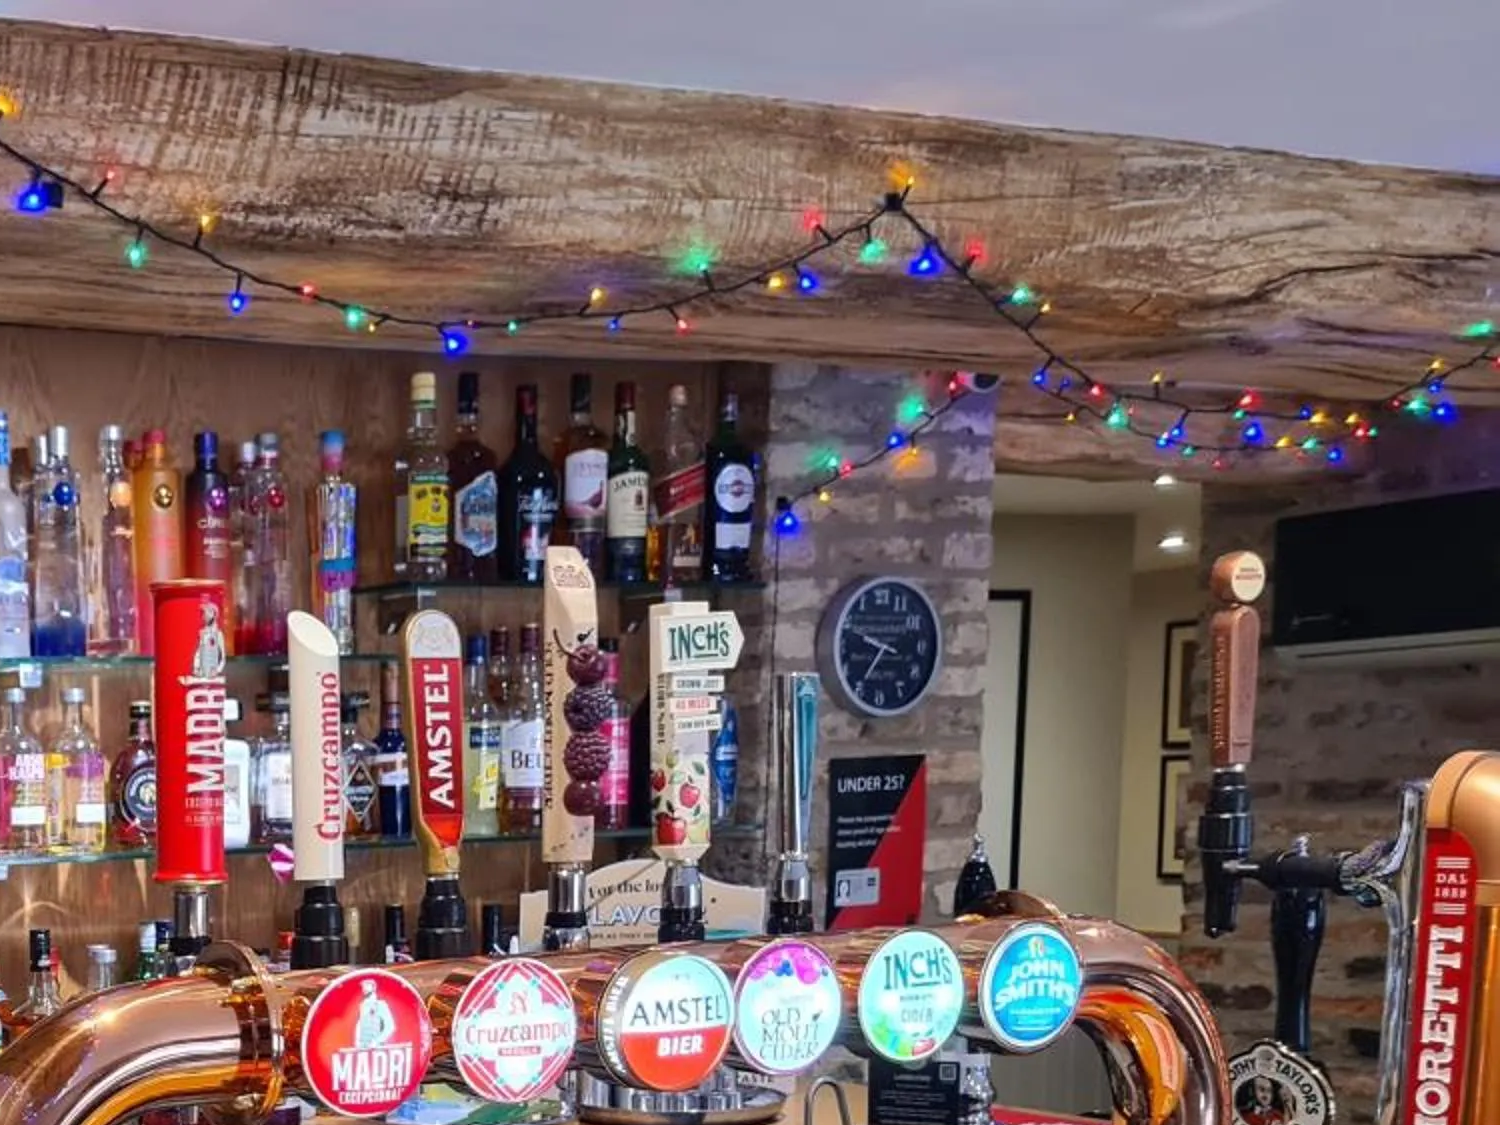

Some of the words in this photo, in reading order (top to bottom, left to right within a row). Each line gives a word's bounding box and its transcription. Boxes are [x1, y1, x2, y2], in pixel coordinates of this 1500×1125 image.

[423, 664, 455, 808] AMSTEL
[317, 671, 342, 842] Cruzcampo
[837, 776, 881, 793] UNDER
[884, 775, 905, 790] 25?
[1010, 959, 1066, 981] JOHN
[629, 994, 725, 1028] AMSTEL
[761, 1007, 802, 1025] OLD
[465, 1022, 572, 1044] Cruzcampo
[657, 1034, 705, 1057] BIER
[759, 1042, 820, 1061] CIDER
[1275, 1059, 1321, 1116] TAYLOR'S
